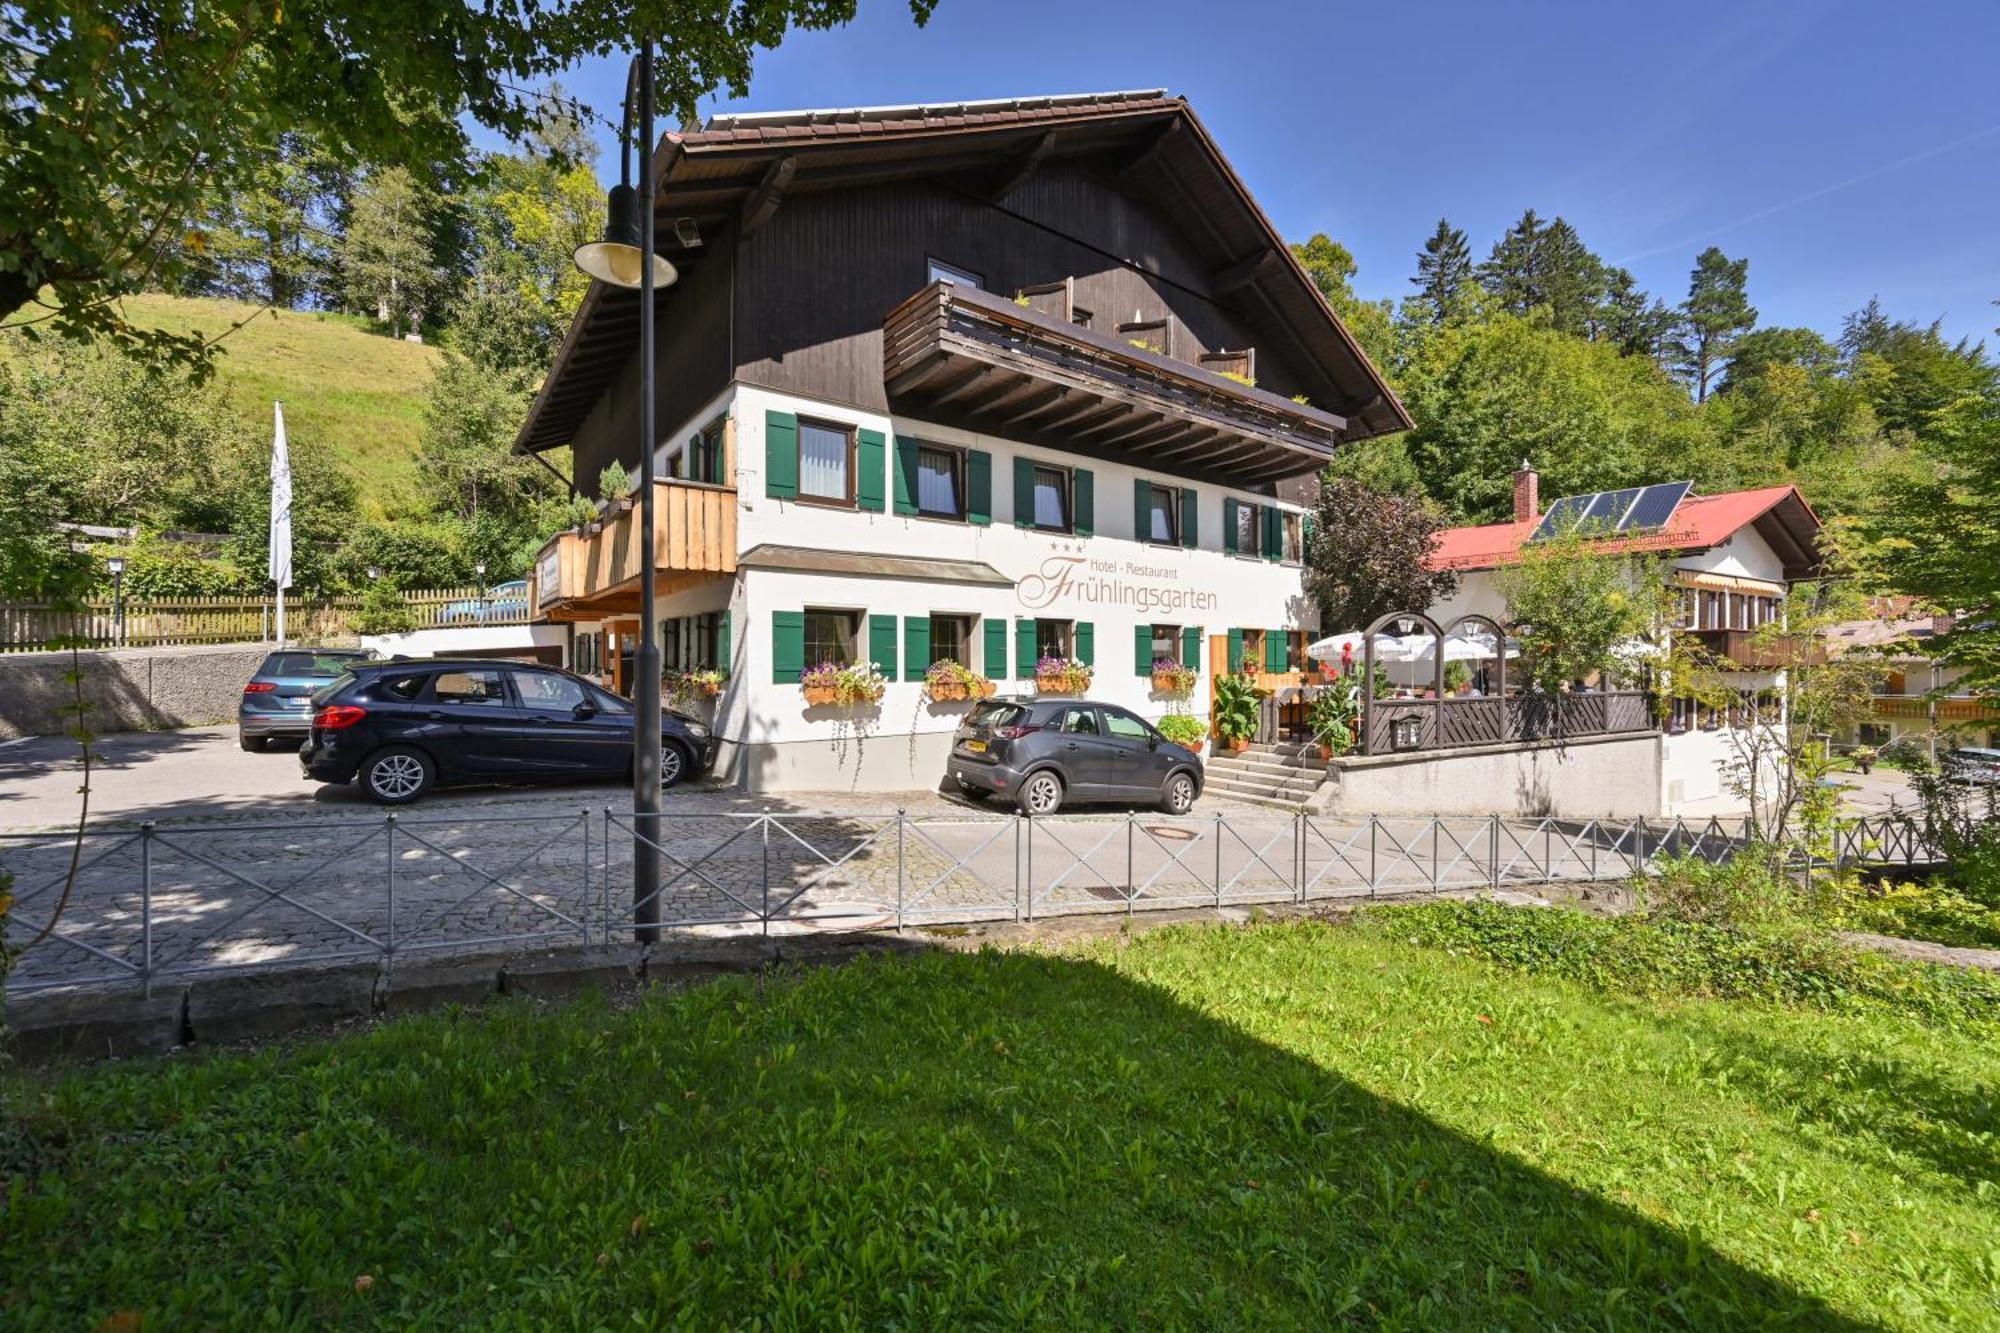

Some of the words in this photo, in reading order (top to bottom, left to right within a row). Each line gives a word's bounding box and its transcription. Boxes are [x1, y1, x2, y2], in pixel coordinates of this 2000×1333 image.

[1017, 556, 1217, 613] Frühlingsgarten
[1090, 559, 1117, 573] Hotel
[1126, 562, 1178, 579] Restaurant
